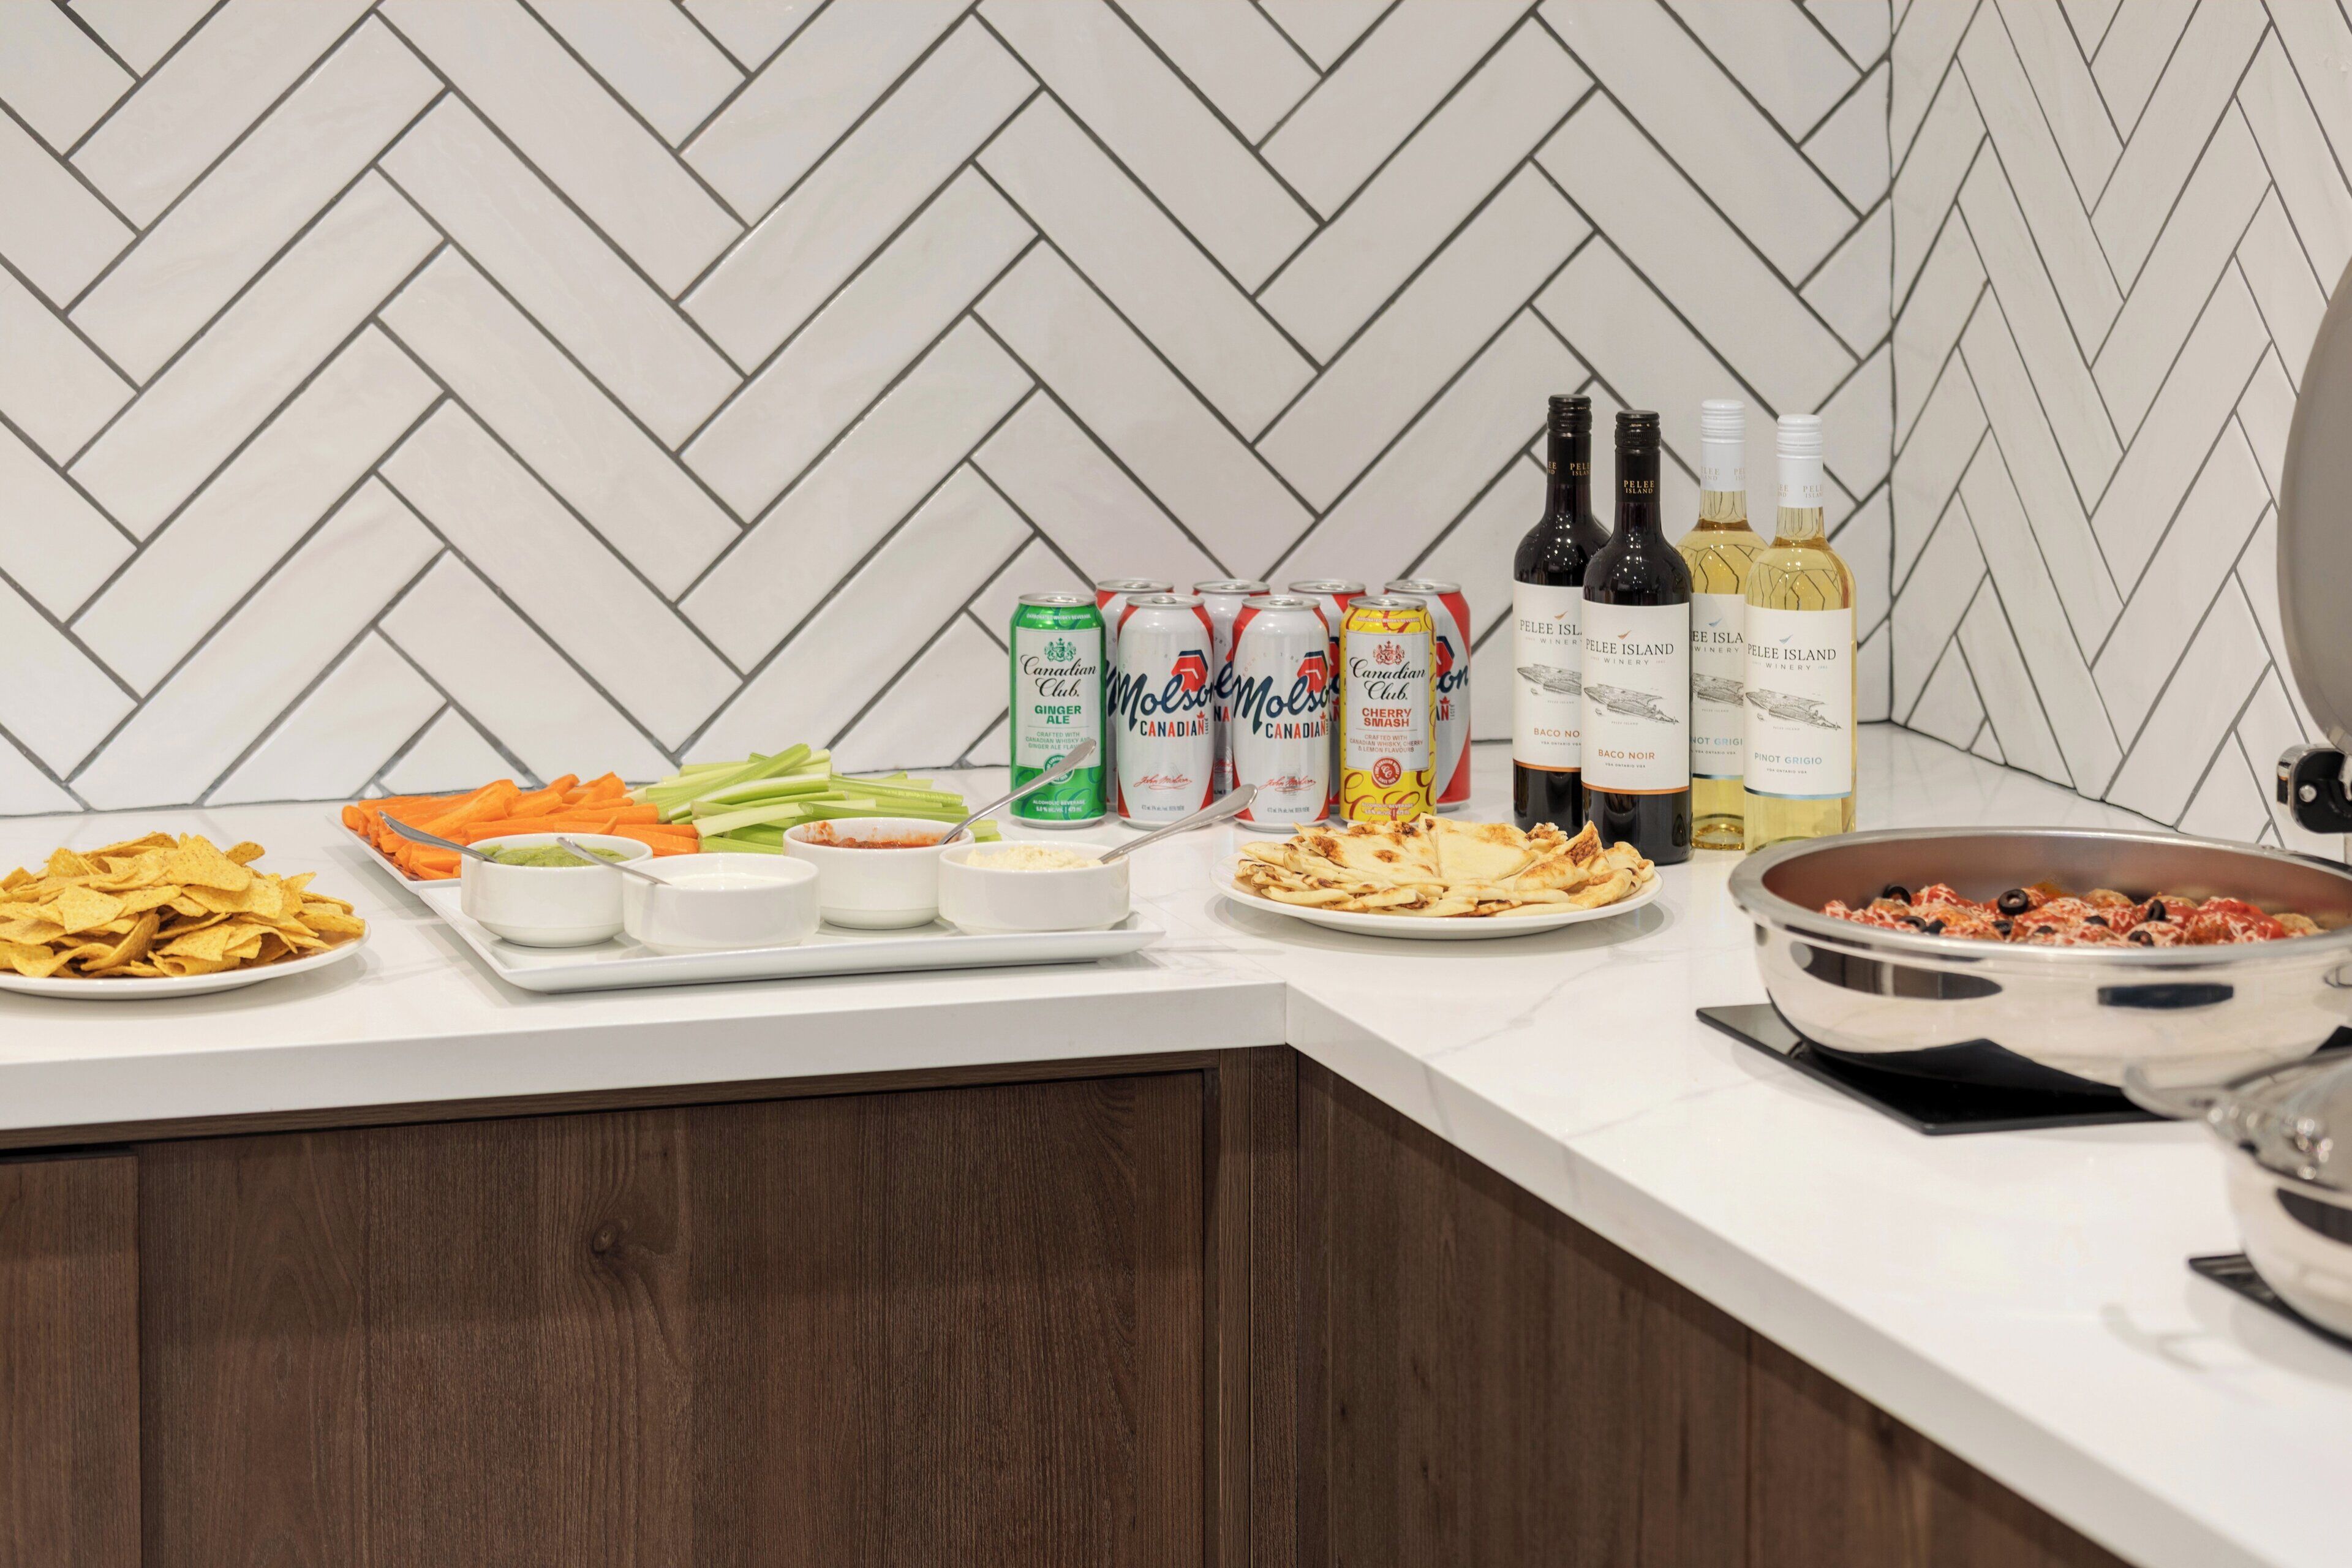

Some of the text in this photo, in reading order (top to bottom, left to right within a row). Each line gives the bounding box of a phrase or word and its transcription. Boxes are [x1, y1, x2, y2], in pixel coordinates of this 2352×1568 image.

[1624, 480, 1654, 488] PELEE
[1520, 619, 1582, 635] PELEE ISL
[1713, 632, 1743, 643] ISLA
[1586, 638, 1674, 655] PELEE ISLAND
[1748, 644, 1836, 661] PELEE ISLAND
[1020, 654, 1096, 676] Canadian
[1349, 657, 1425, 679] Canadian
[1035, 705, 1082, 715] GINGER
[1232, 674, 1329, 735] Molso
[1362, 707, 1412, 717] CHERRY
[1046, 715, 1070, 725] ALE
[1364, 718, 1409, 727] SMASH
[1140, 720, 1205, 737] CANADIAN
[1265, 720, 1326, 739] CANADIAN
[1534, 728, 1561, 737] BACO
[1691, 736, 1710, 745] NOT
[1598, 749, 1624, 759] BACO
[1754, 752, 1822, 765] PINOT GRIGIO
